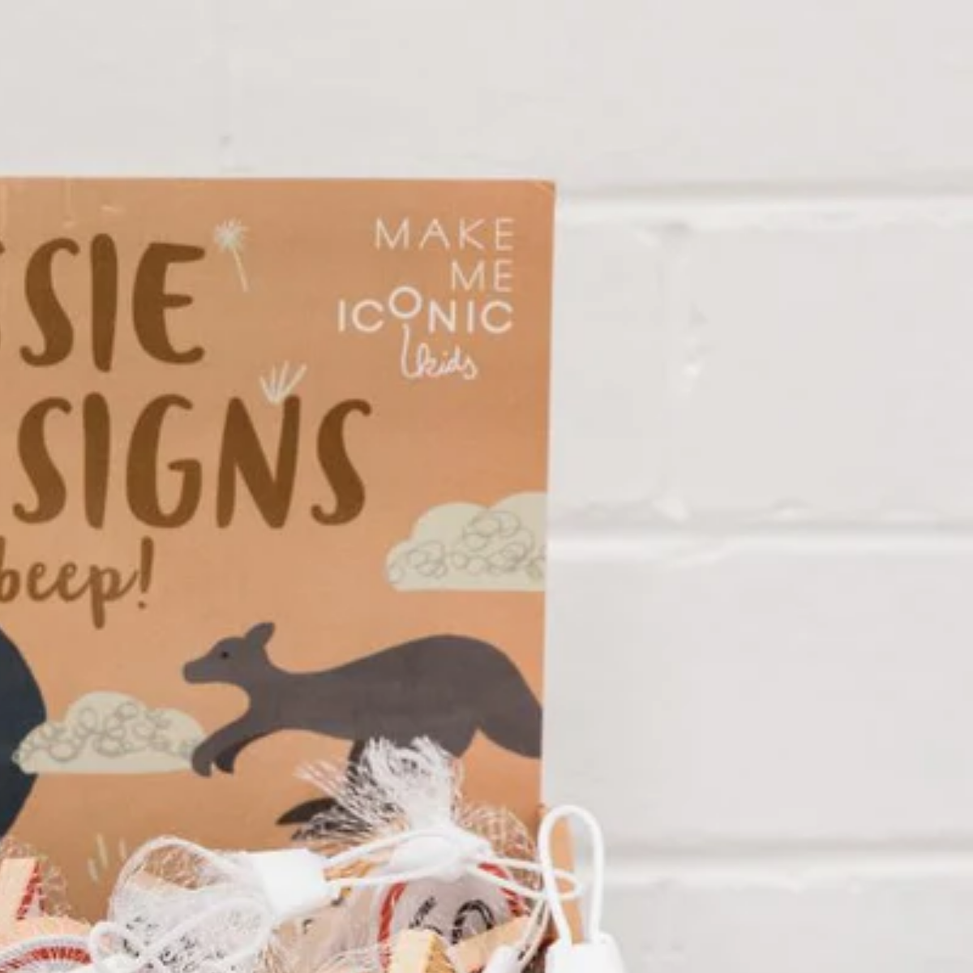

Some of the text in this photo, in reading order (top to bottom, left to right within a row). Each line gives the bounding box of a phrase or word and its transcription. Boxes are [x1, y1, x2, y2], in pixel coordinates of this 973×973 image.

[374, 217, 514, 249] MAKE
[451, 259, 514, 292] ME
[338, 285, 514, 334] ICONIC
[401, 342, 478, 380] kids
[12, 392, 373, 529] SIGNS
